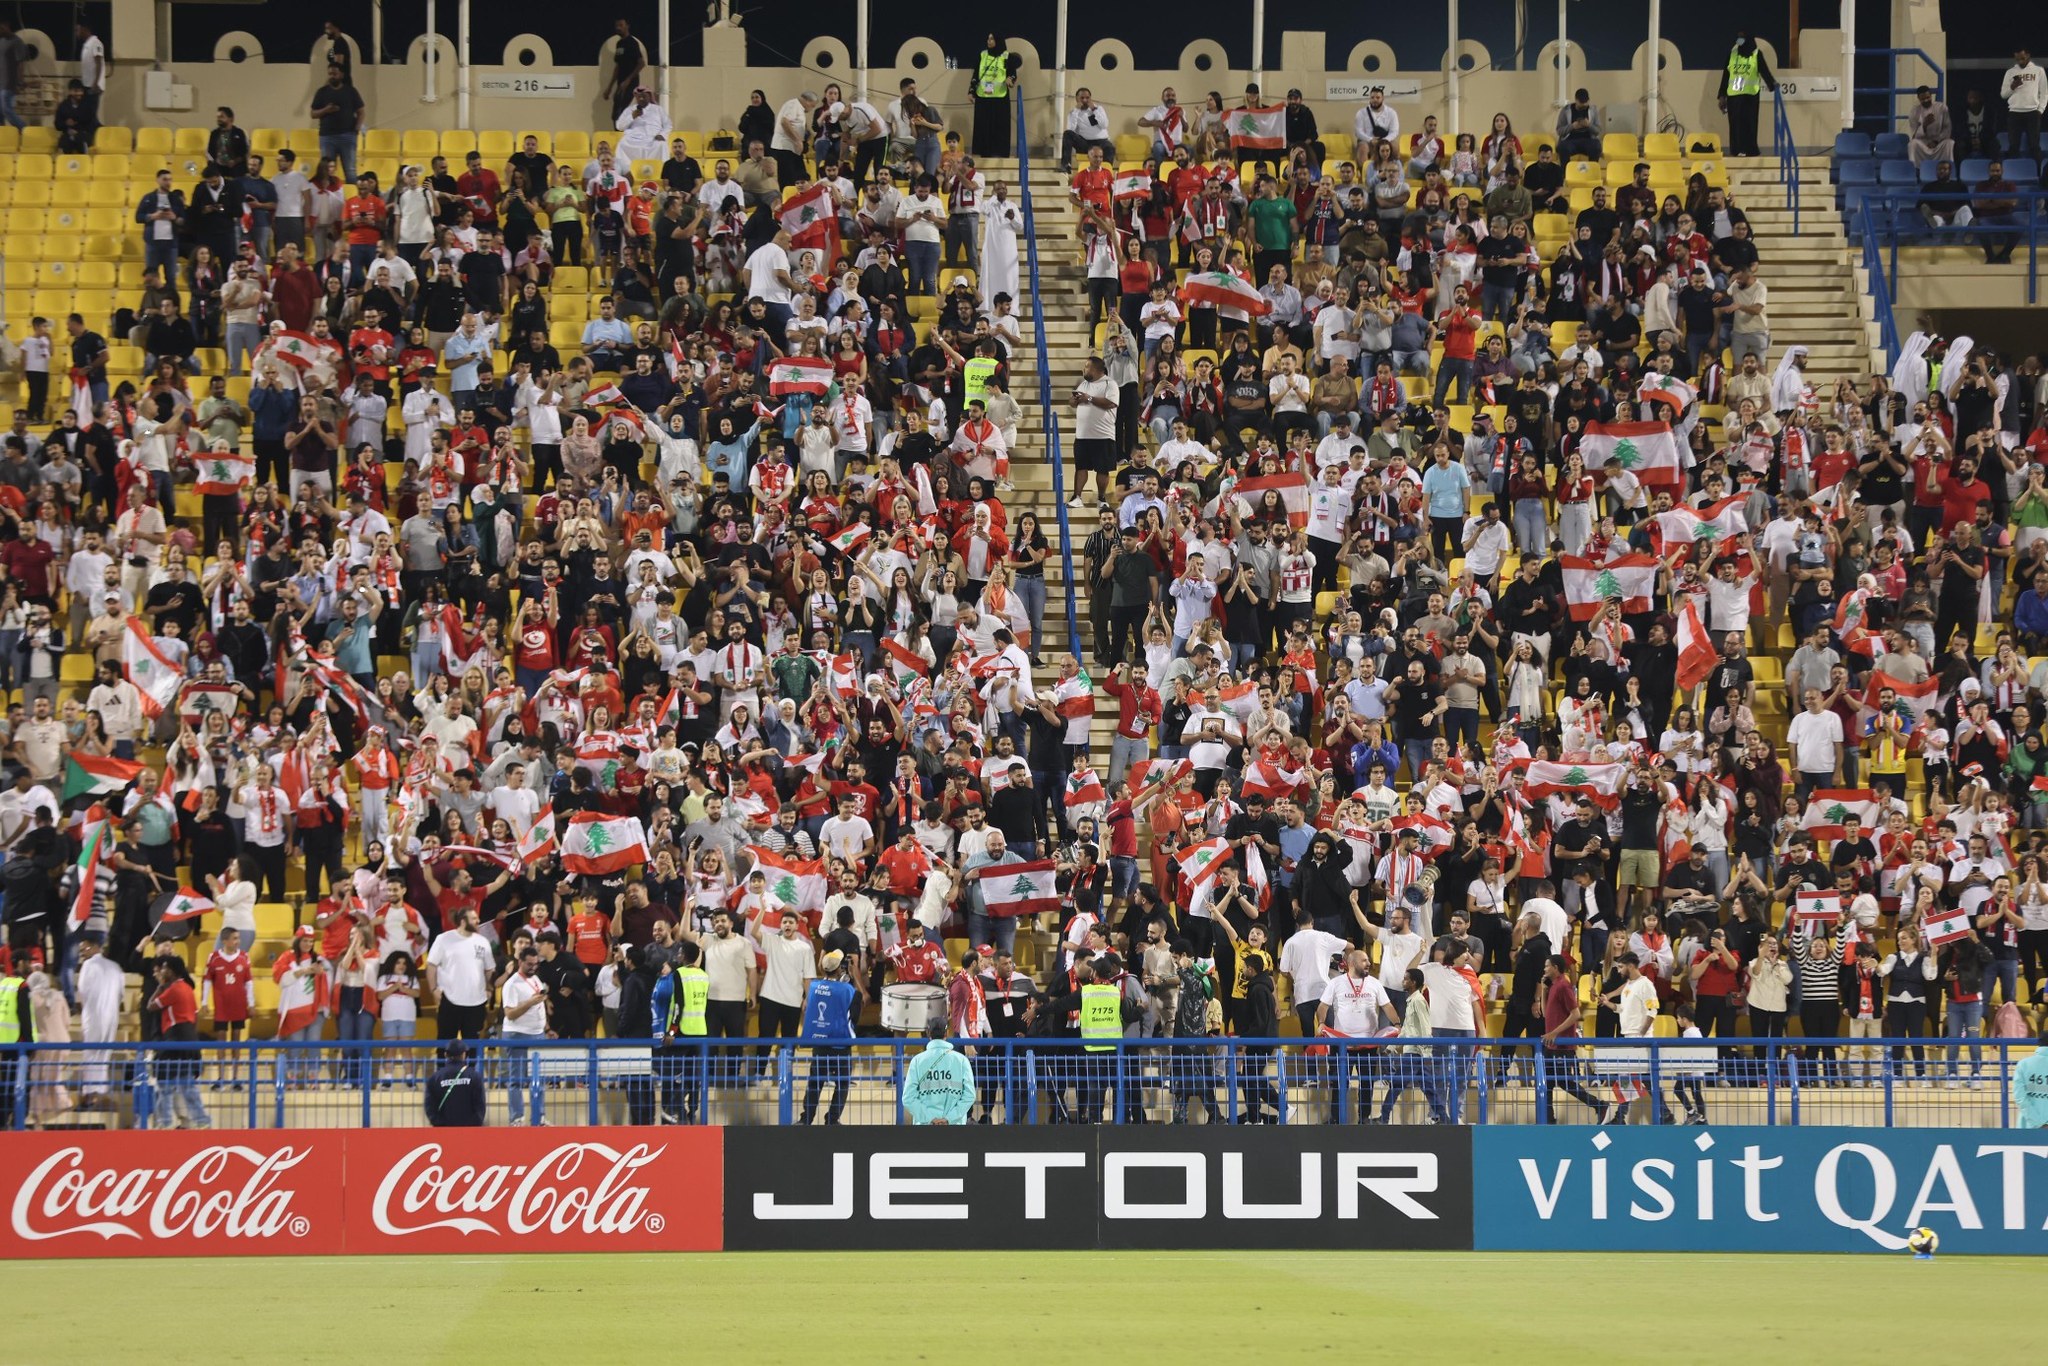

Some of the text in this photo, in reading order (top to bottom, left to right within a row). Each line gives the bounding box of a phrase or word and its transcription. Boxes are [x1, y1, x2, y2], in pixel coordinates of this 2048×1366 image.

[514, 80, 538, 91] 216
[913, 964, 923, 975] 12
[225, 973, 236, 985] 16
[926, 1070, 952, 1080] 4016
[753, 1152, 1440, 1220] JETOUR
[1518, 1131, 2048, 1250] visit QAT
